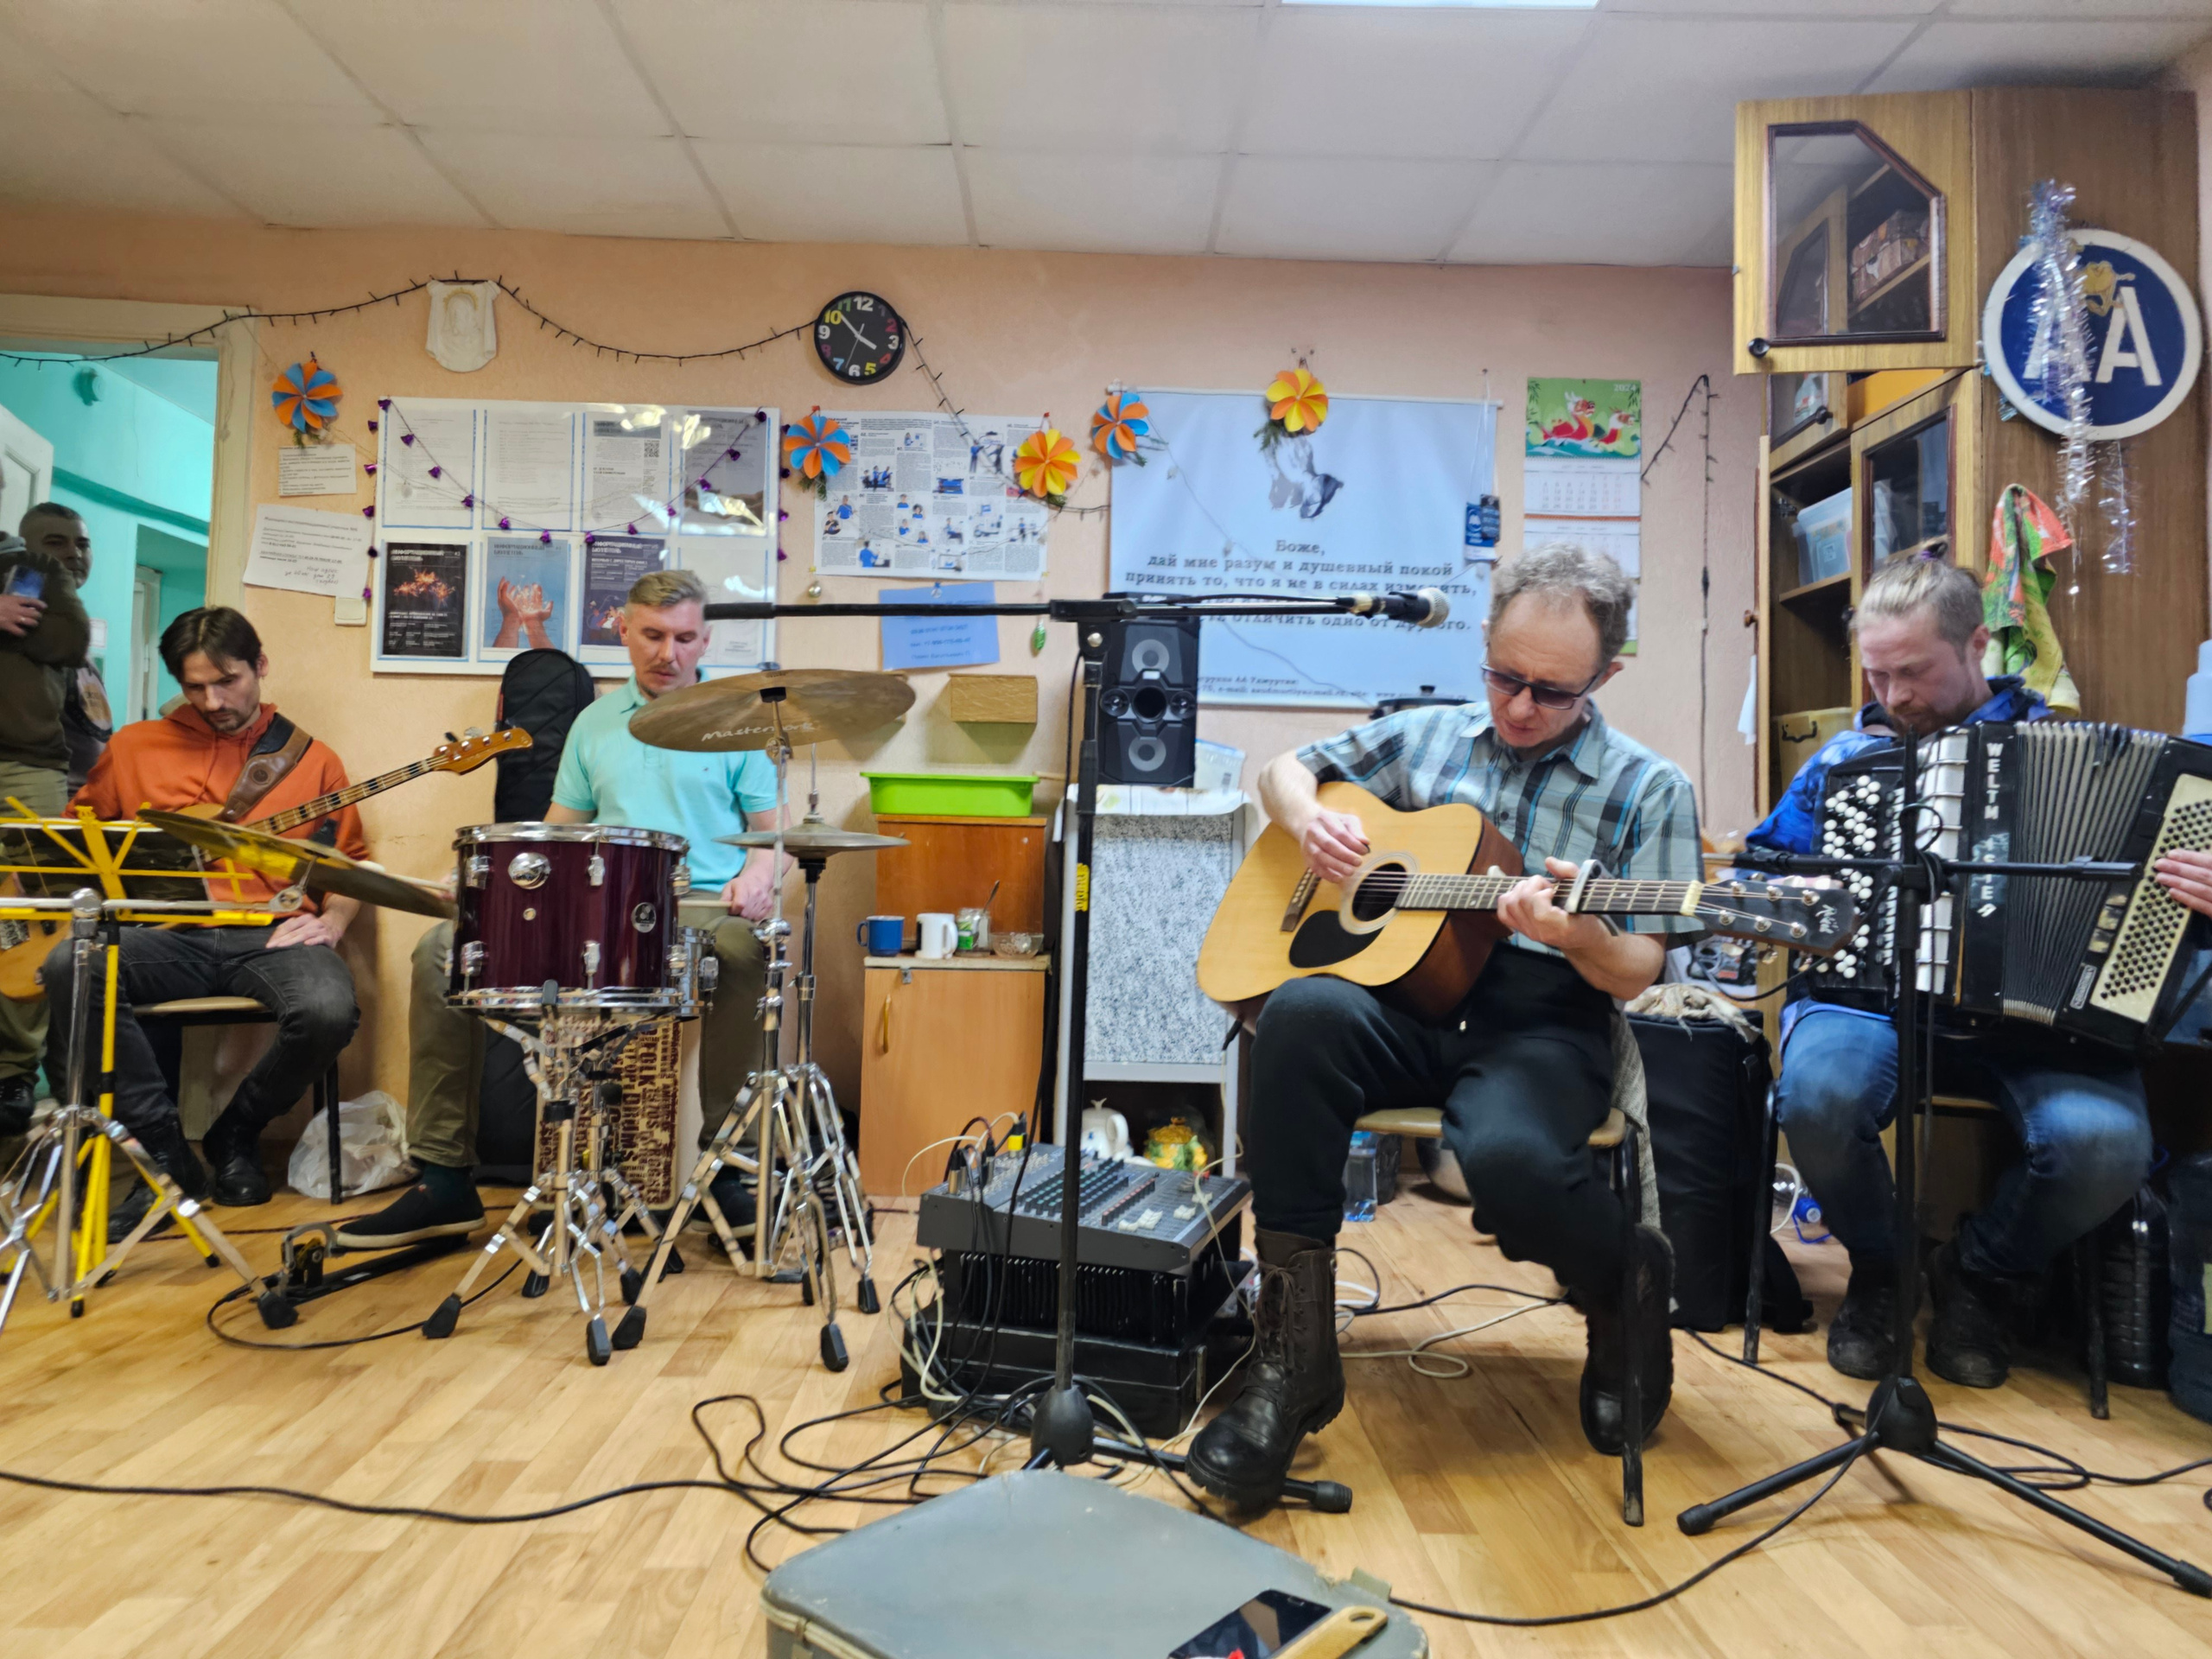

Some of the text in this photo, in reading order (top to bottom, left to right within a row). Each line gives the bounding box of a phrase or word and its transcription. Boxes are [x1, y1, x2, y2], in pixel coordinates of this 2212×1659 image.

[837, 297, 852, 312] 11
[853, 296, 874, 311] 12
[824, 309, 842, 325] 10
[818, 325, 830, 339] 9
[885, 318, 898, 333] 2
[887, 334, 899, 350] 3
[833, 357, 844, 371] 7
[880, 353, 891, 364] 4
[849, 364, 861, 377] 6
[864, 362, 876, 376] 5
[1613, 383, 1637, 393] 2024
[1275, 539, 1325, 556] Боже,
[1147, 554, 1453, 575] дай мне разум и душевный покой
[1125, 571, 1197, 586] принять
[1202, 576, 1229, 588] то,
[1235, 577, 1265, 588] что
[1271, 578, 1281, 588] я
[1287, 579, 1307, 589] не
[1313, 580, 1323, 590] в
[1329, 581, 1378, 591] силах
[1321, 616, 1365, 626] одно
[1370, 617, 1389, 627] от
[702, 721, 815, 741] Masterork
[639, 1042, 658, 1086] FOLK
[621, 1093, 640, 1162] DRUMS
